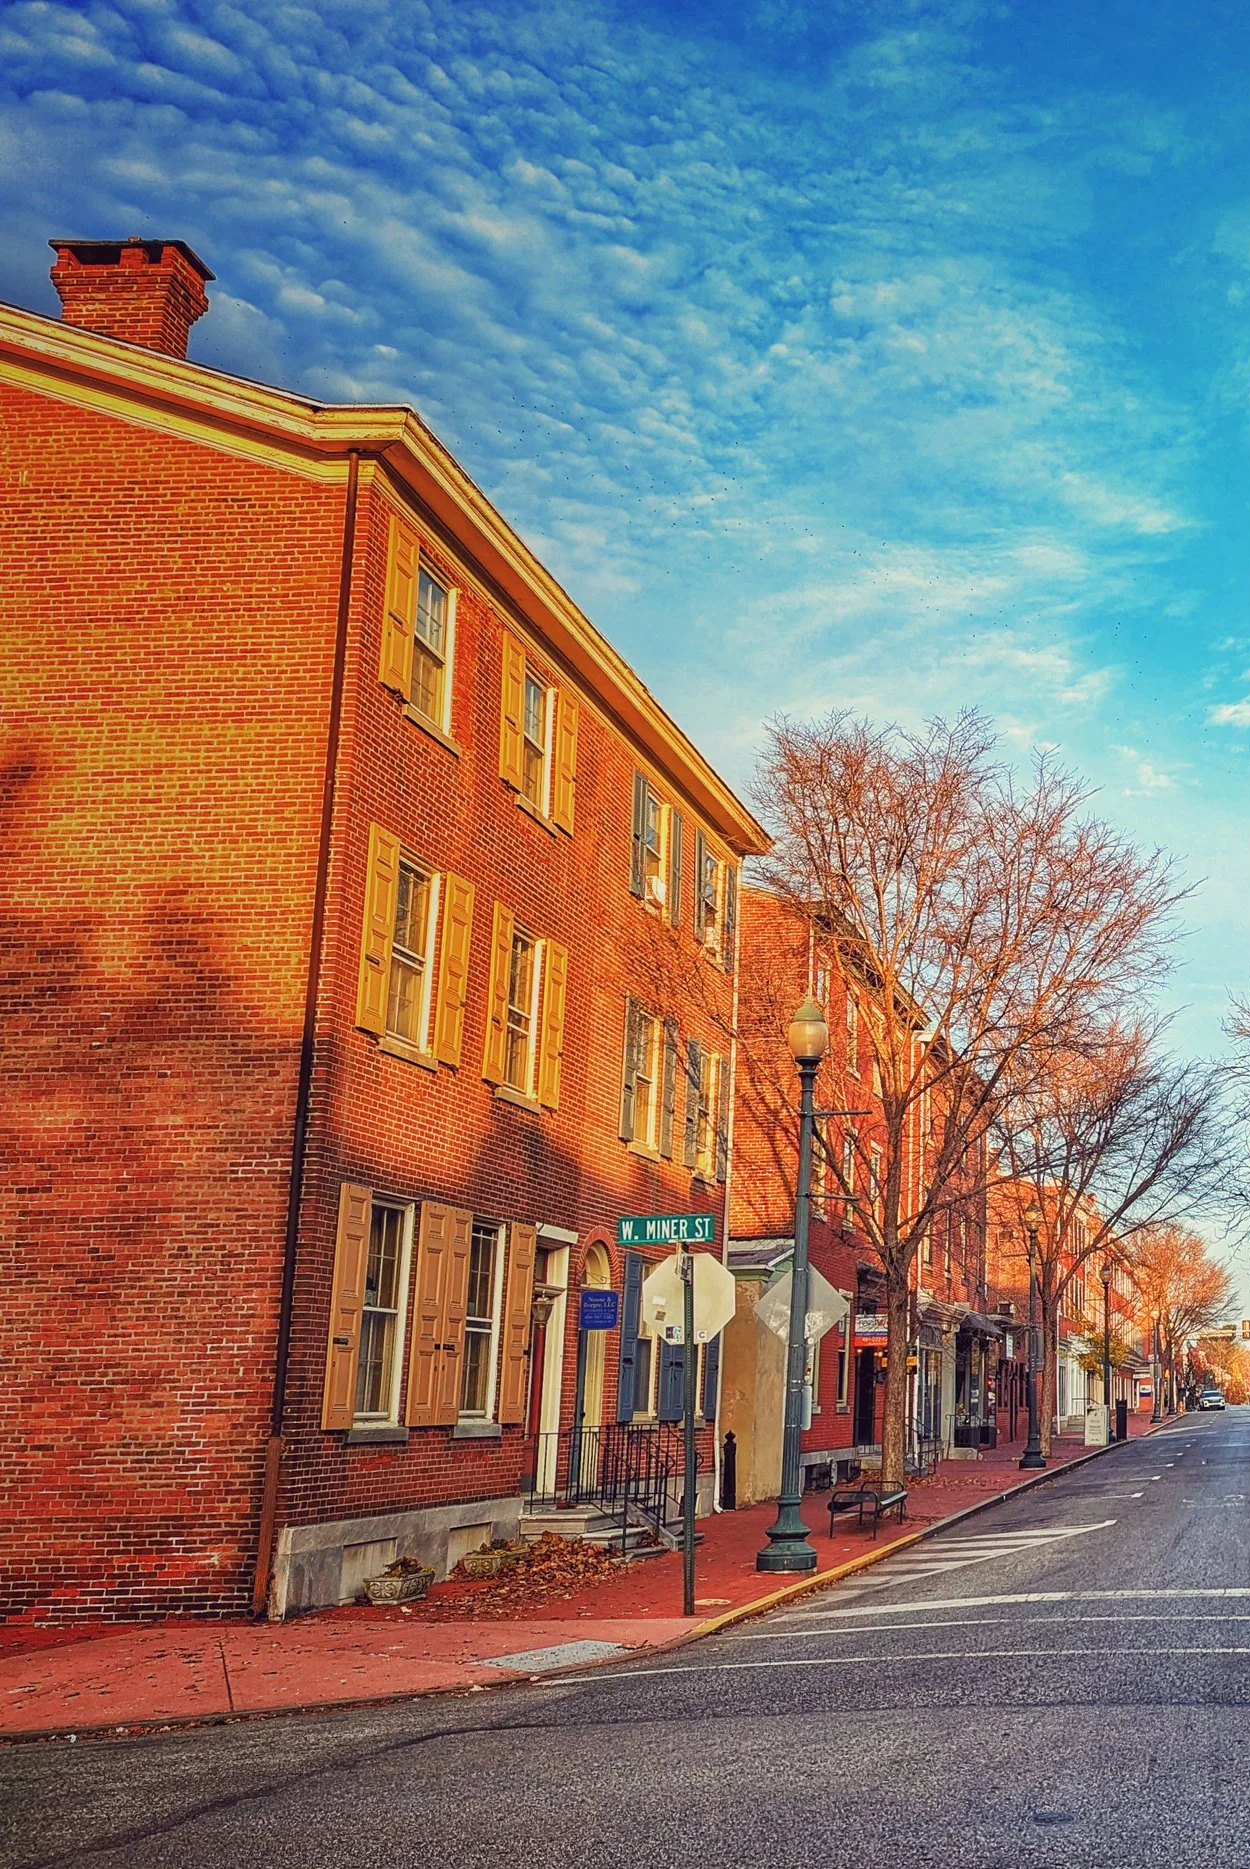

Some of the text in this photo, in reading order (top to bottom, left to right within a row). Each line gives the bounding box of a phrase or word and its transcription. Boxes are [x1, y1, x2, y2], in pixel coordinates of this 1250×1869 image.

[621, 1218, 711, 1241] W. MINER ST
